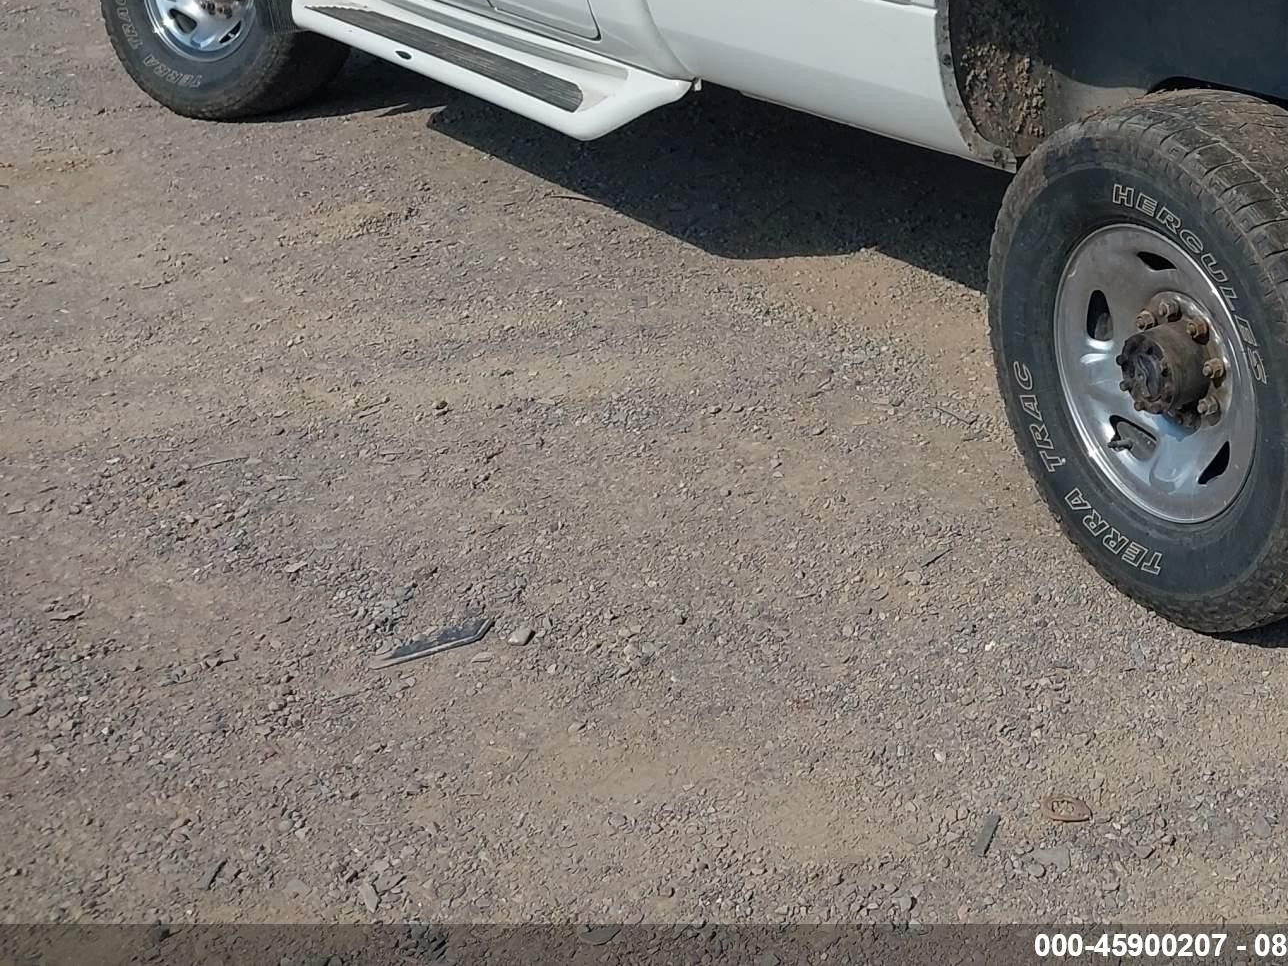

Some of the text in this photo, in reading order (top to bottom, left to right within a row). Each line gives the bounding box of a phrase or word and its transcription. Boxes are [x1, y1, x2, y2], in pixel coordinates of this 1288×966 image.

[1112, 183, 1269, 386] HERCULES
[1013, 361, 1067, 472] TRAC
[1064, 487, 1164, 576] TERRA
